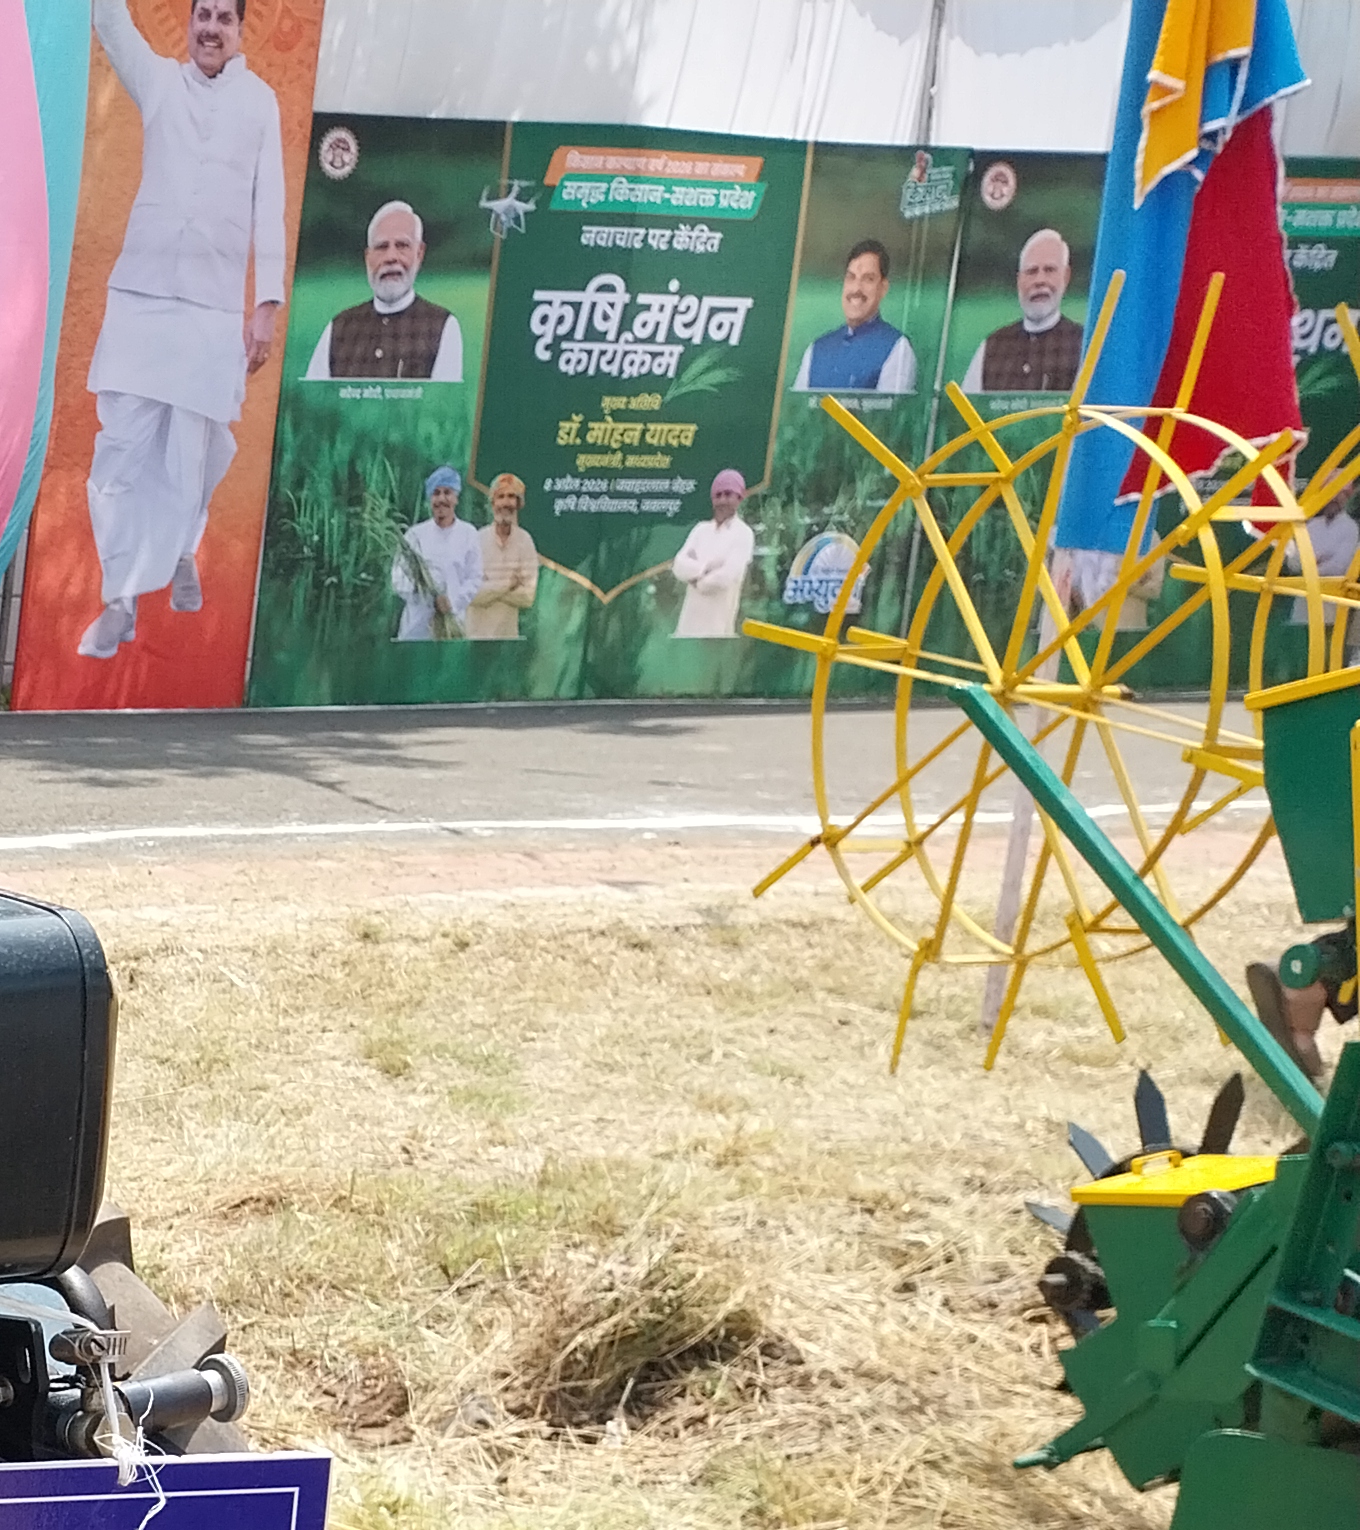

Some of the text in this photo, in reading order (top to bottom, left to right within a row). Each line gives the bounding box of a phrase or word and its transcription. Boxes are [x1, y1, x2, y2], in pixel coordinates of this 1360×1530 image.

[581, 223, 722, 253] नवाचार पर केंद्रित
[530, 273, 754, 361] कृषि मंथन
[558, 331, 684, 379] कार्यक्रम
[556, 413, 698, 448] डॉ. मोहन यादव
